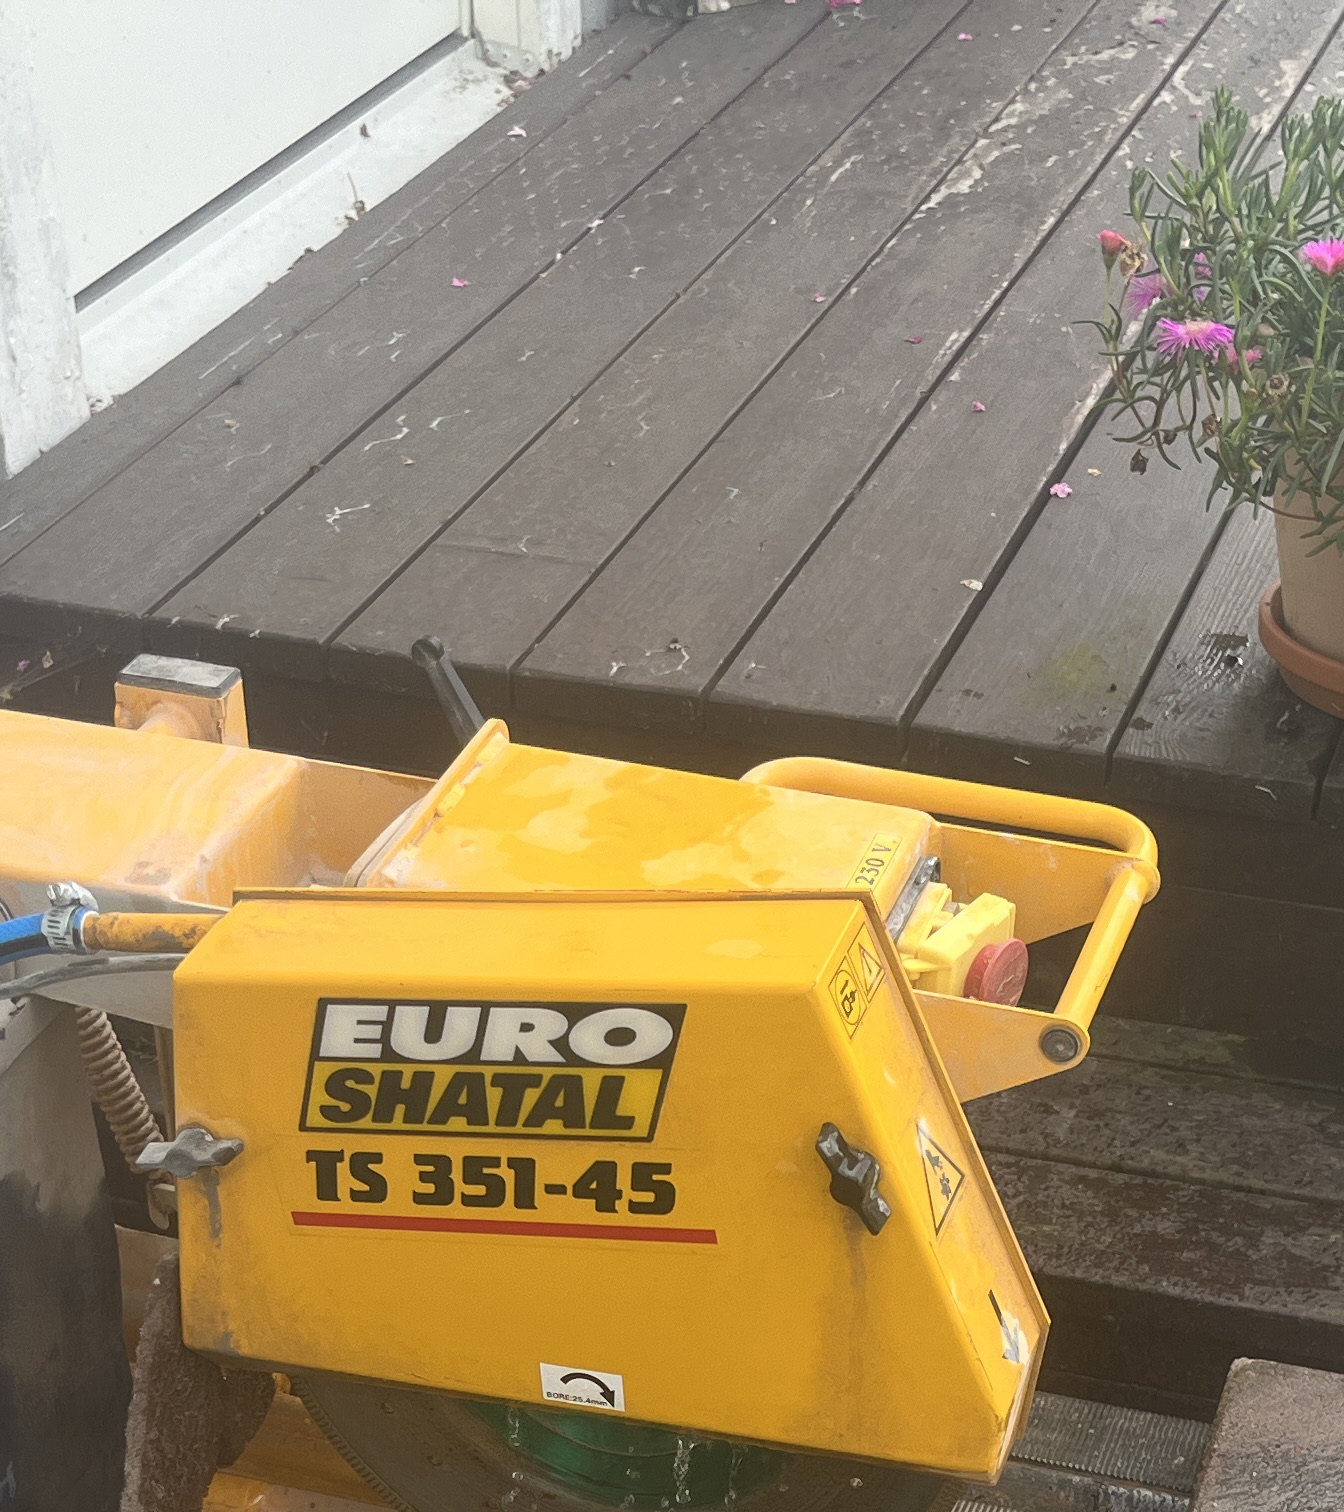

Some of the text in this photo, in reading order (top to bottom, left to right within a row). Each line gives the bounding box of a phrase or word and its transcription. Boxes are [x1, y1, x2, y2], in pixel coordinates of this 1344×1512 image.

[855, 858, 885, 885] 230
[318, 1004, 674, 1065] EURO
[319, 1068, 636, 1130] SHATAL
[305, 1149, 676, 1215] TS 351-45
